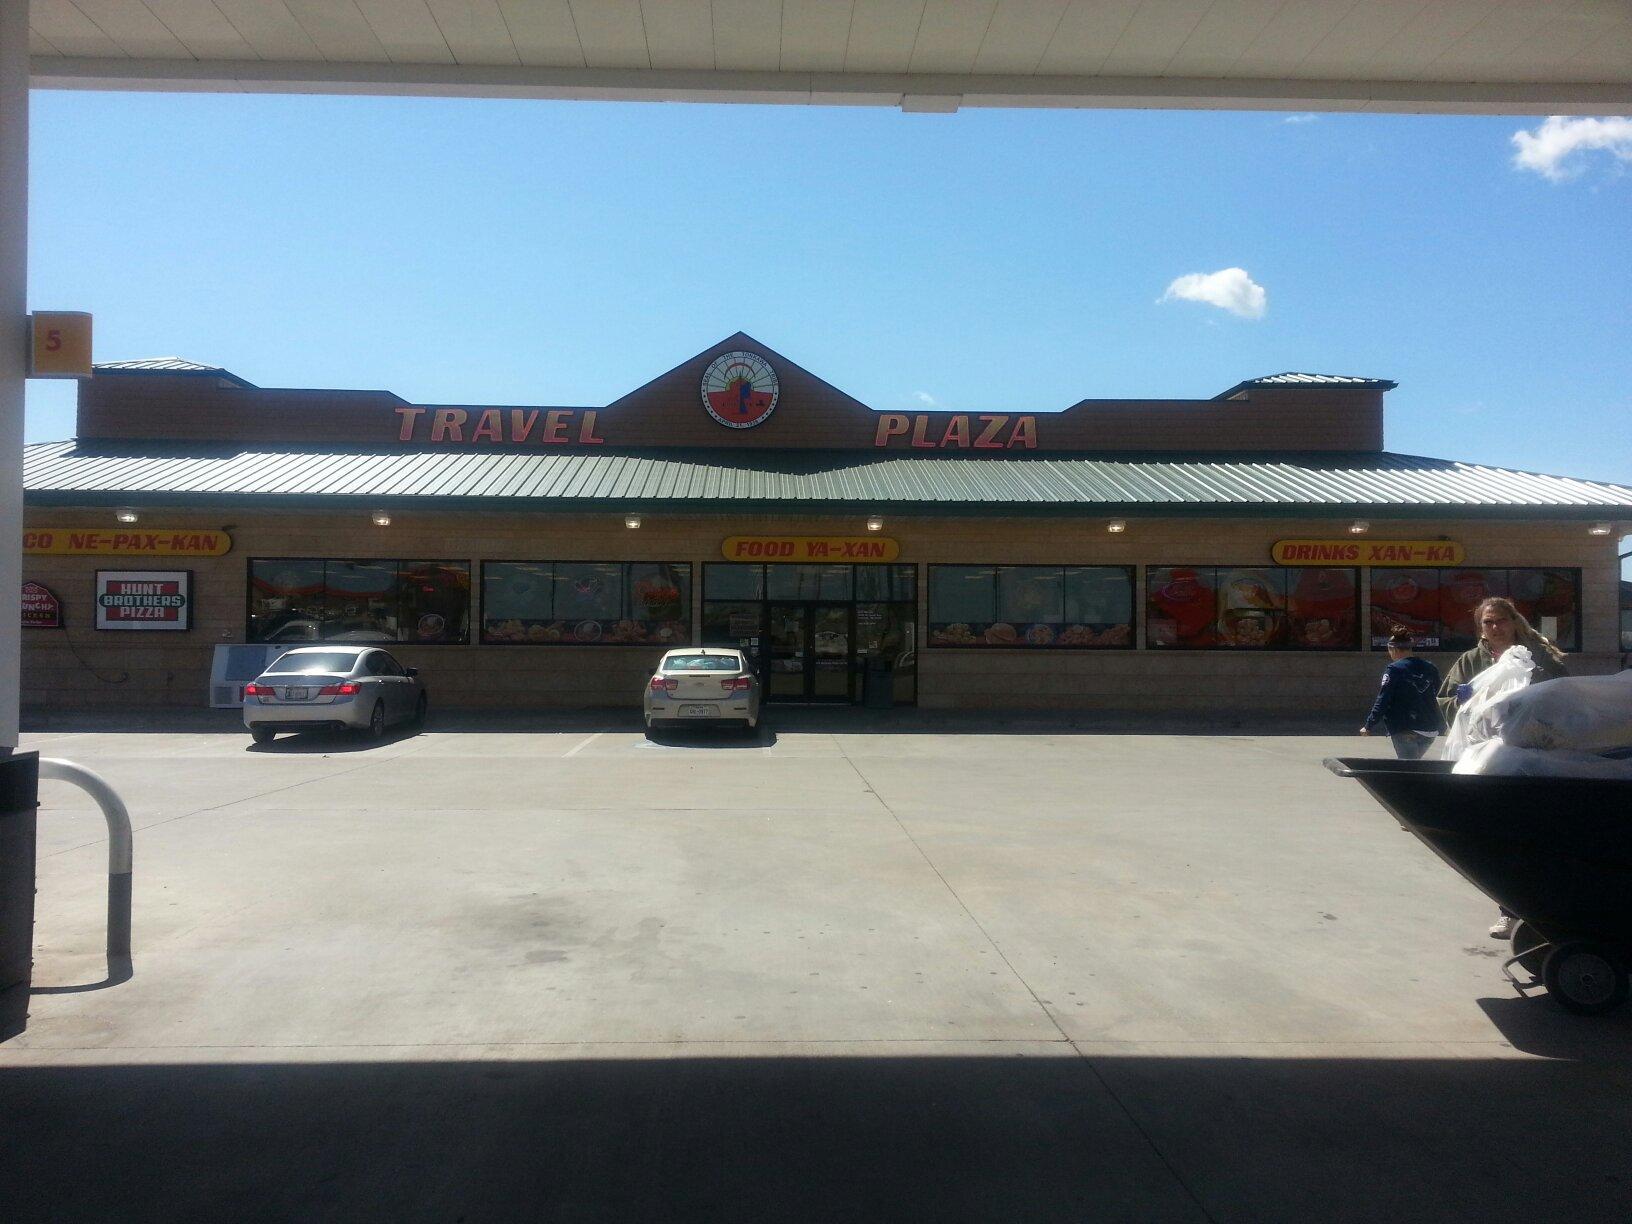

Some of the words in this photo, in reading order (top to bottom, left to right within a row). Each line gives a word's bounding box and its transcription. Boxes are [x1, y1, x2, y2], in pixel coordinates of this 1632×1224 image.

[46, 330, 61, 351] 5
[395, 407, 604, 443] TRAVEL
[875, 414, 1038, 448] PLAZA
[68, 533, 218, 550] NE-PAX-KAN
[735, 541, 794, 557] FOOD
[806, 541, 886, 558] YA-XAN
[1281, 544, 1360, 561] DRINKS
[1368, 545, 1455, 561] XAN-KA
[121, 583, 163, 595] HUNT
[103, 594, 181, 606] BROTHERS
[119, 606, 165, 618] PIZZA
